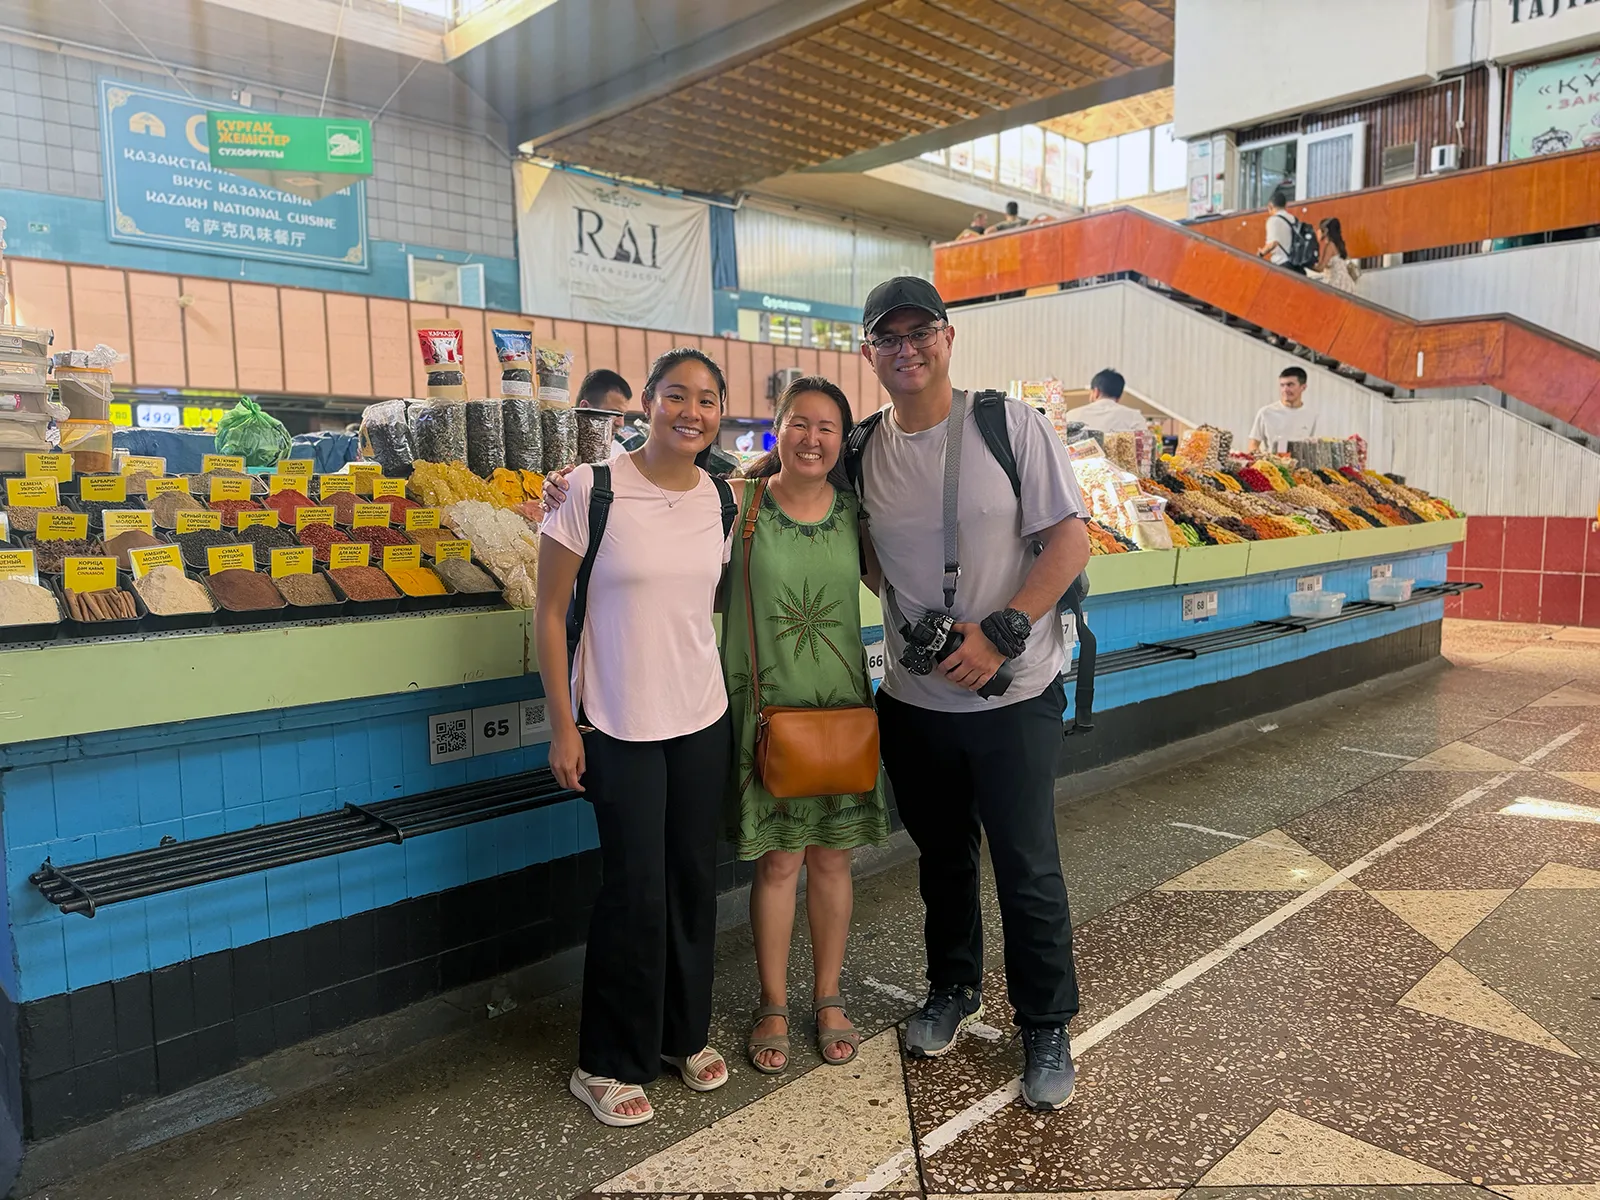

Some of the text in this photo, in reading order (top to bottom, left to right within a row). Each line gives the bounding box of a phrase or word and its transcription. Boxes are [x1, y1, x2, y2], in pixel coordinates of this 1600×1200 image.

[1509, 0, 1600, 24] TAJ
[218, 132, 291, 146] ЖЕМІСТЕР
[218, 147, 284, 158] СУХОФРУКТЫ
[172, 174, 312, 207] ВКУС КАЗАХСТАНА
[146, 190, 337, 230] KAZAKH NATIONAL CUISINE
[185, 216, 306, 248] 哈萨克风味餐厅
[572, 205, 662, 270] RAI
[869, 655, 883, 668] 66
[484, 719, 509, 738] 65
